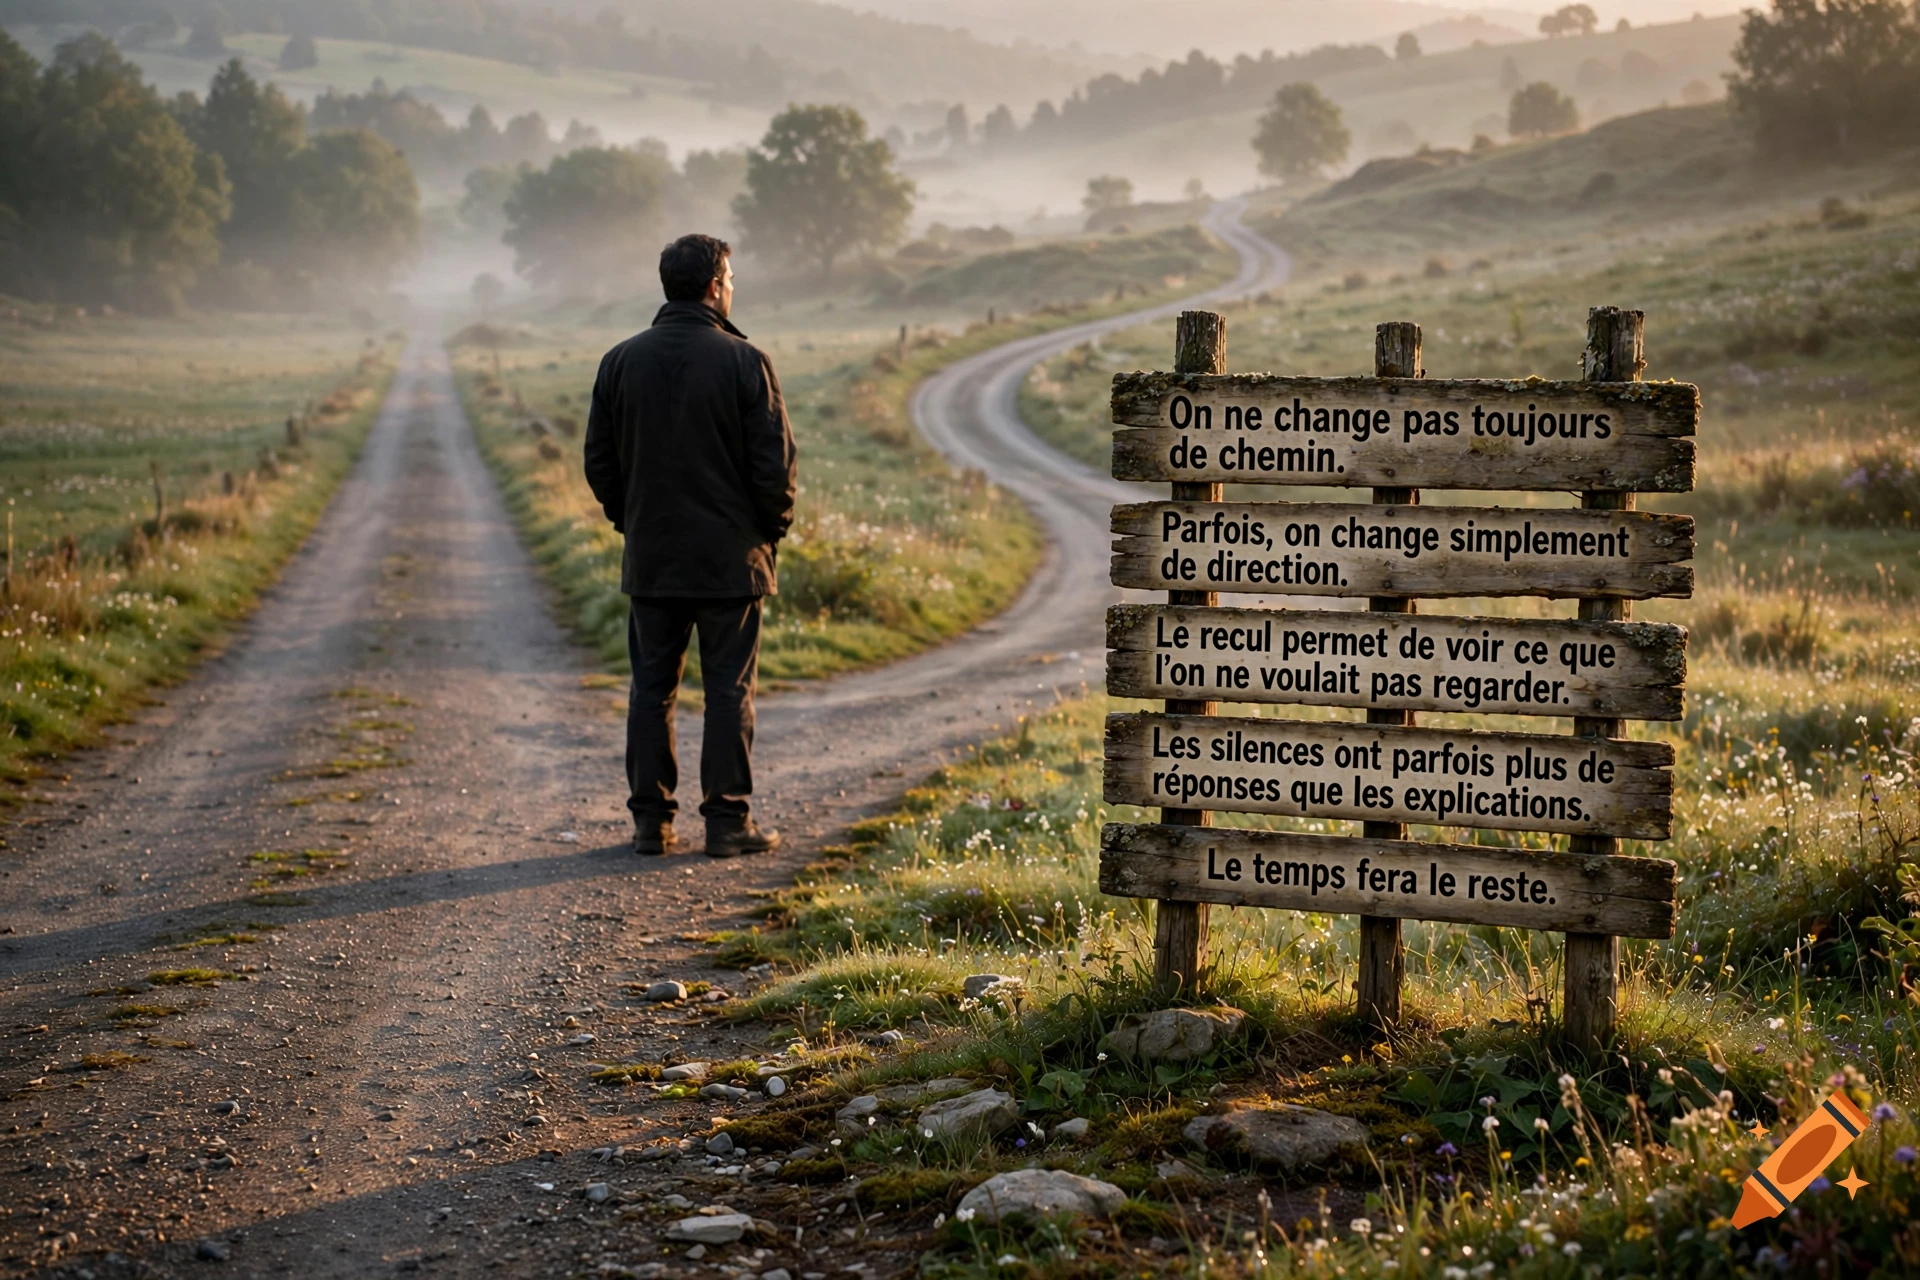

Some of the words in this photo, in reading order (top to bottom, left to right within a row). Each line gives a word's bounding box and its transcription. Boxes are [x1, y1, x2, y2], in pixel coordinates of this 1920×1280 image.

[1169, 395, 1212, 430] On
[1224, 405, 1262, 431] ne
[1274, 397, 1391, 441] change
[1403, 410, 1460, 443] pas
[1471, 403, 1612, 446] toujours
[1169, 435, 1207, 470] de
[1219, 437, 1345, 474] chemin.
[1162, 510, 1273, 552] Parfois,
[1284, 523, 1320, 547] on
[1331, 516, 1439, 559] change
[1450, 519, 1630, 562] simplement
[1161, 548, 1197, 581] de
[1207, 549, 1348, 587] direction.
[1156, 616, 1190, 649] Le
[1200, 620, 1272, 652] recul
[1282, 627, 1388, 661] permet
[1399, 627, 1435, 660] de
[1445, 630, 1505, 663] voir
[1514, 640, 1549, 665] ce
[1559, 642, 1616, 675] que
[1216, 665, 1250, 689] ne
[1259, 661, 1360, 695] voulait
[1370, 672, 1422, 703] pas
[1433, 670, 1570, 708] regarder.
[1153, 726, 1201, 760] Les
[1210, 730, 1324, 767] silences
[1334, 740, 1382, 771] ont
[1392, 741, 1495, 779] parfois
[1505, 746, 1567, 787] plus
[1578, 750, 1615, 784] de
[1153, 763, 1281, 804] réponses
[1290, 780, 1343, 812] que
[1354, 775, 1394, 809] les
[1402, 781, 1591, 825] explications.
[1207, 847, 1242, 882] Le
[1252, 852, 1346, 896] temps
[1356, 857, 1417, 894] fera
[1430, 862, 1456, 897] le
[1468, 871, 1556, 905] reste.
